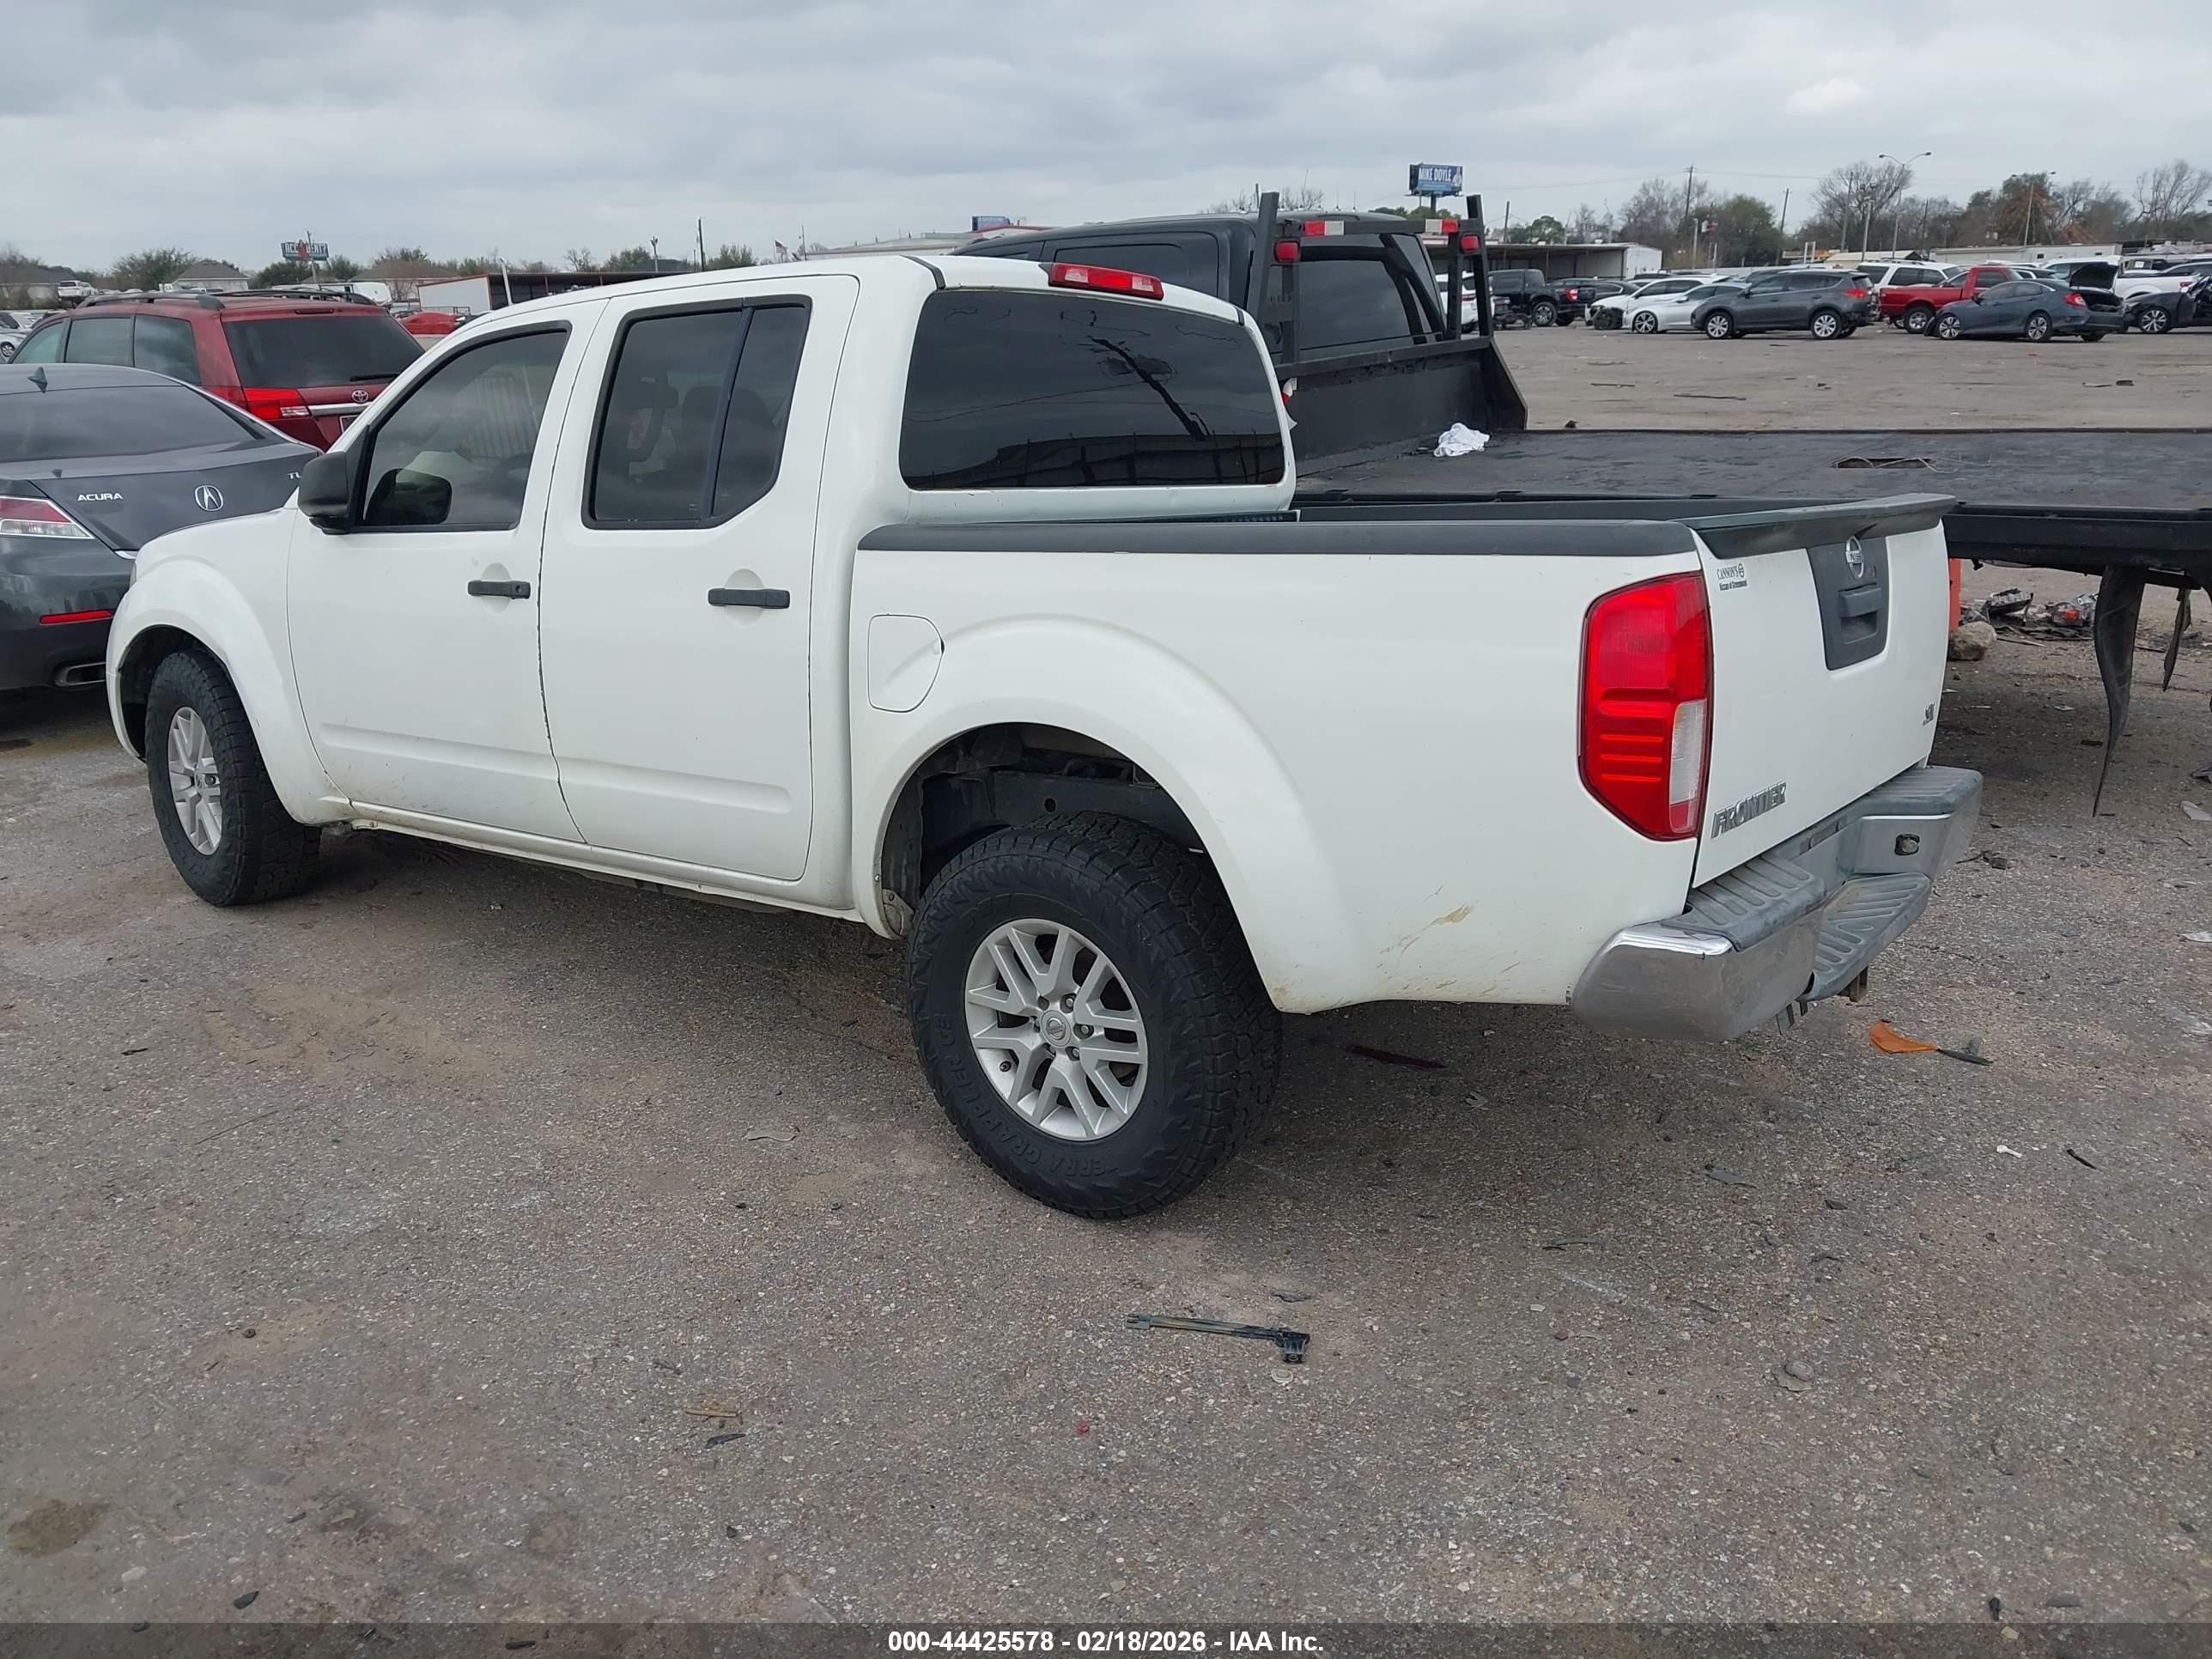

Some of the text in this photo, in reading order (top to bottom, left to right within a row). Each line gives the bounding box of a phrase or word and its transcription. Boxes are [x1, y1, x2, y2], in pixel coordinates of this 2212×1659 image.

[1419, 167, 1452, 181] MIKE DOYLE
[284, 243, 325, 254] ACCDENT?
[77, 492, 124, 501] ACURA
[1711, 781, 1787, 839] FRONTIER
